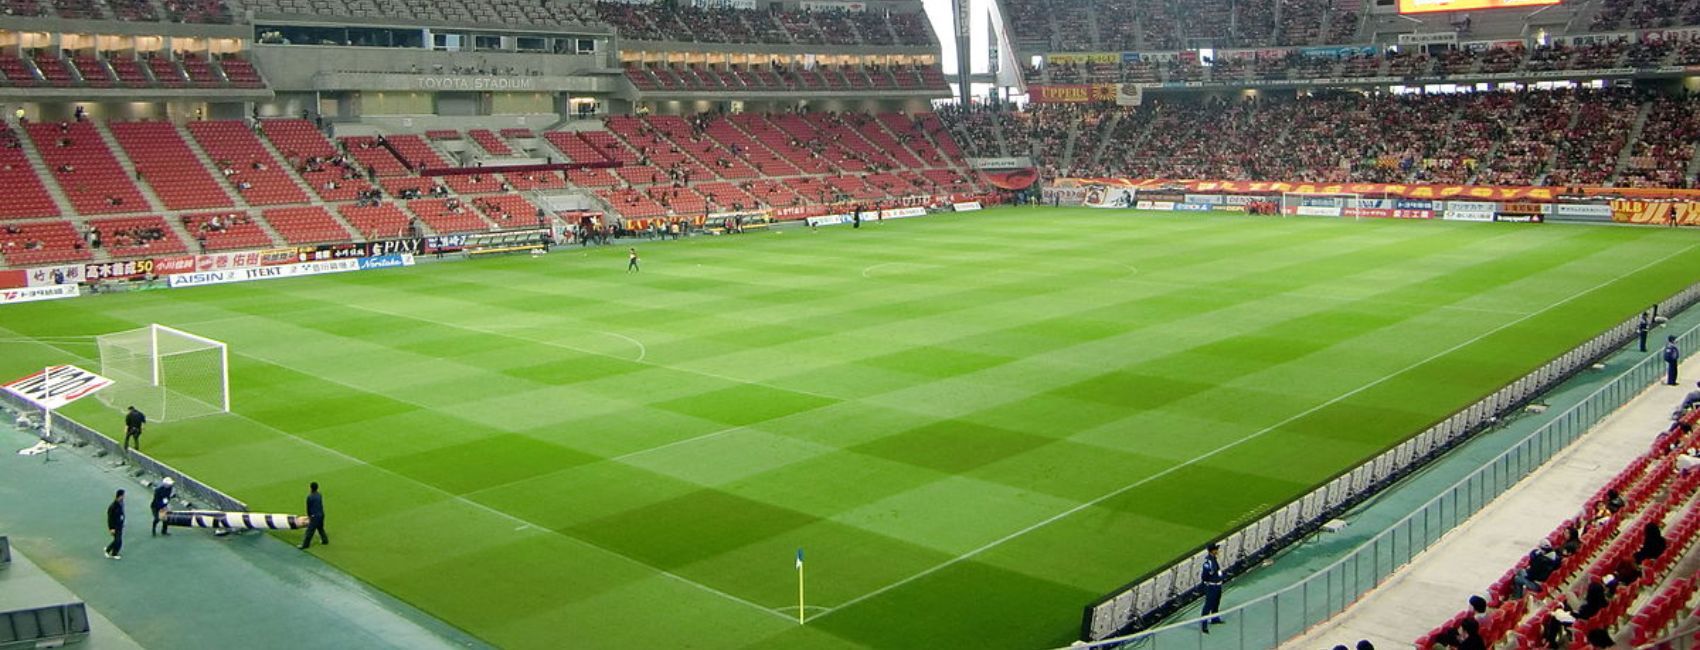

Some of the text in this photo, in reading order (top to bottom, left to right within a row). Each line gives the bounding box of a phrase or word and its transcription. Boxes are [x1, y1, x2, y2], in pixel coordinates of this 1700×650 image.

[417, 78, 530, 89] TOYOTA STADIUM
[1041, 86, 1089, 99] UPPERS
[384, 239, 421, 253] PIXY
[136, 260, 153, 273] 50
[360, 257, 403, 269] Noritake
[175, 272, 224, 285] AISIN
[246, 266, 281, 279] JTEKT
